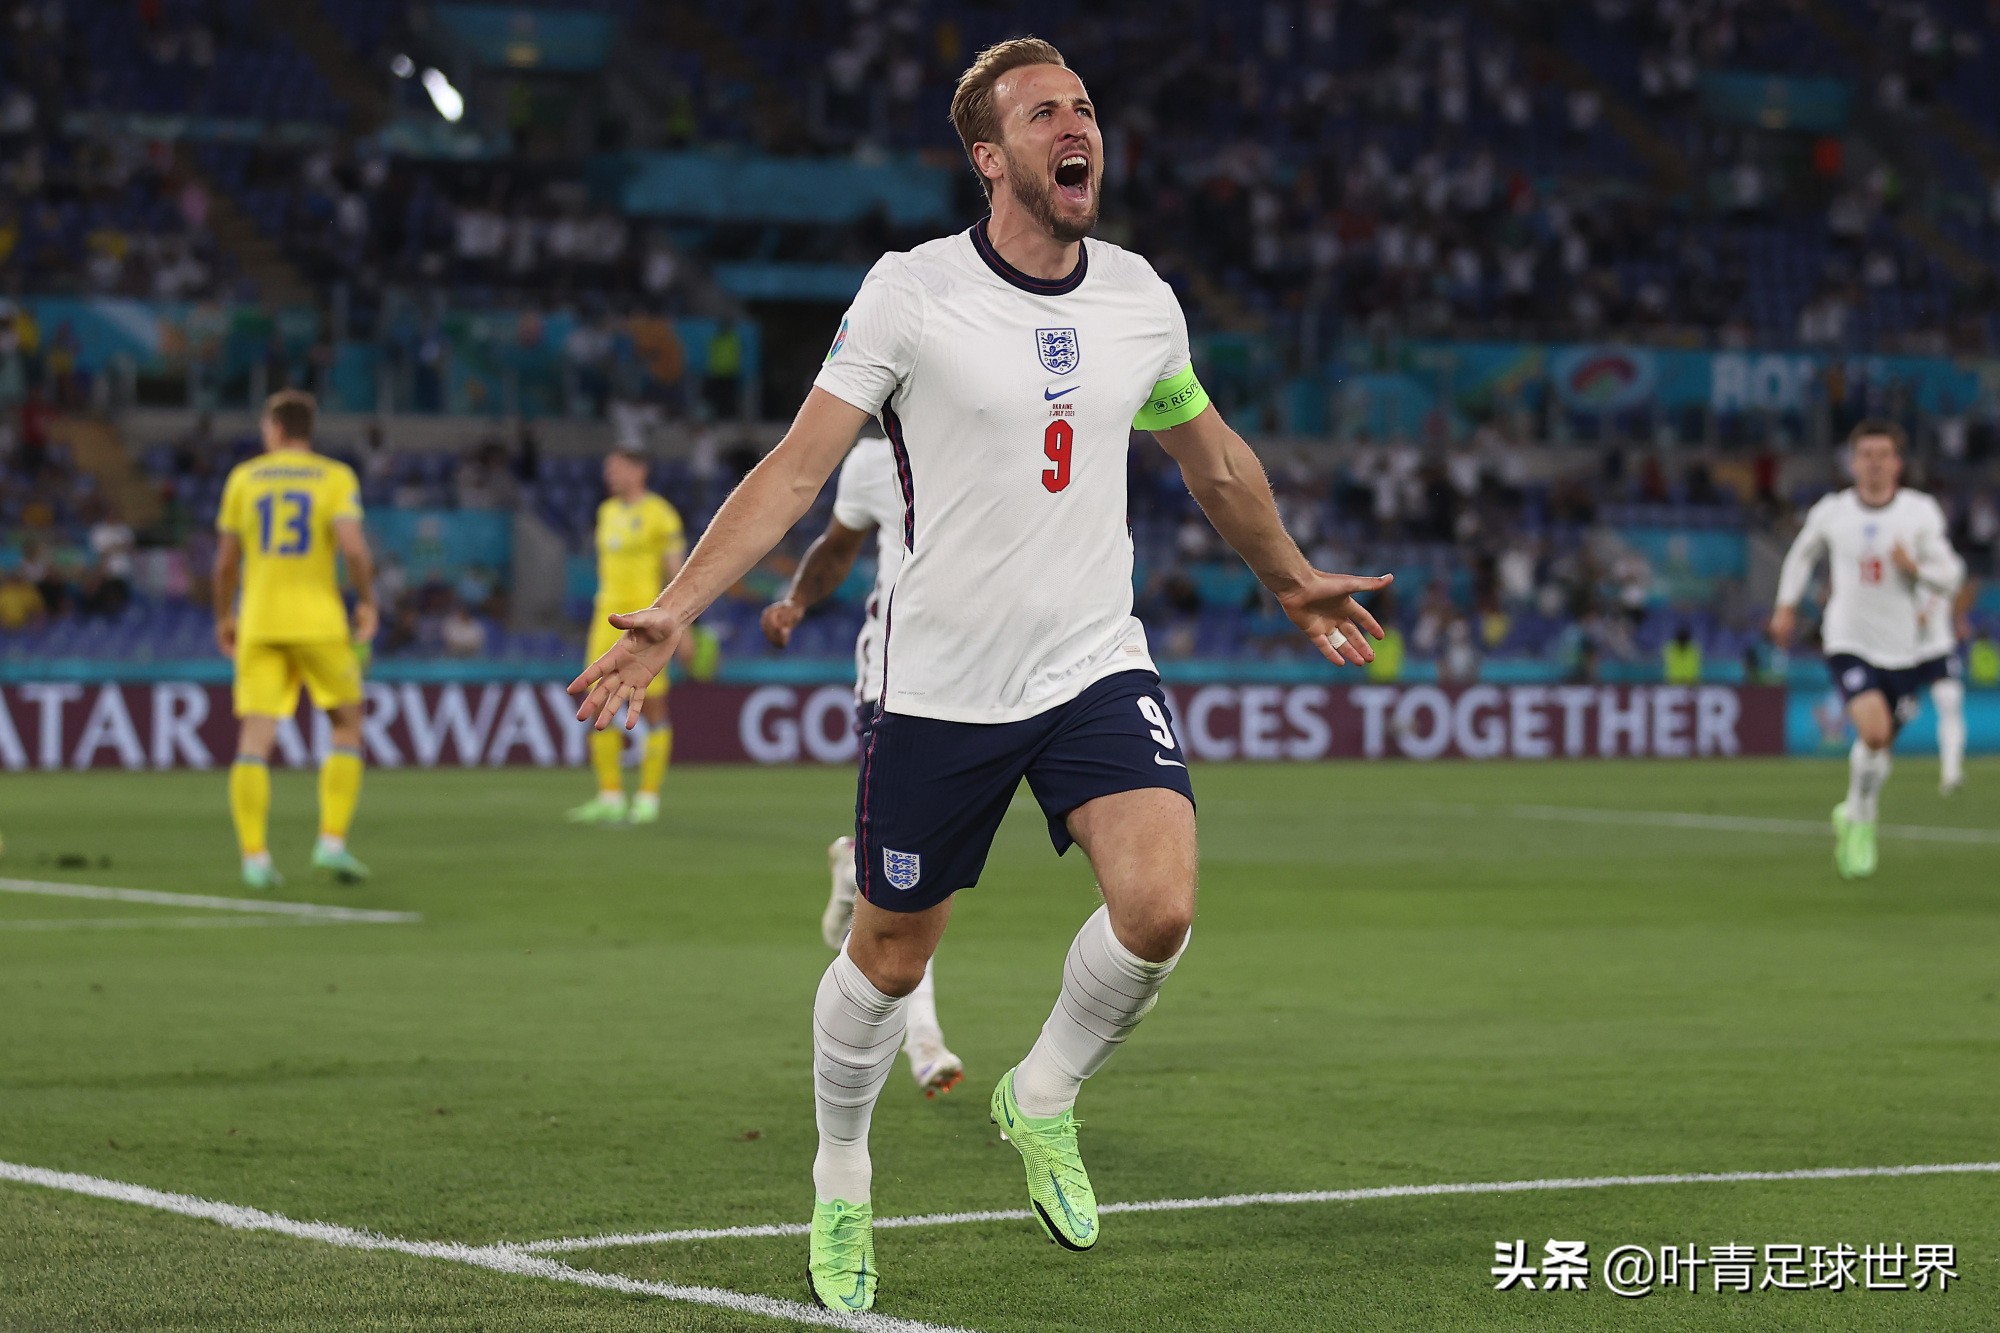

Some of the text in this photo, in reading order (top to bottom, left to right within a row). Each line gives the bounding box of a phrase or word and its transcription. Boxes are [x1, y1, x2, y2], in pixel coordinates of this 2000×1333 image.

[1041, 419, 1073, 493] 9
[256, 491, 312, 555] 13
[1136, 695, 1175, 750] 9
[1350, 684, 1741, 761] TOGETHER
